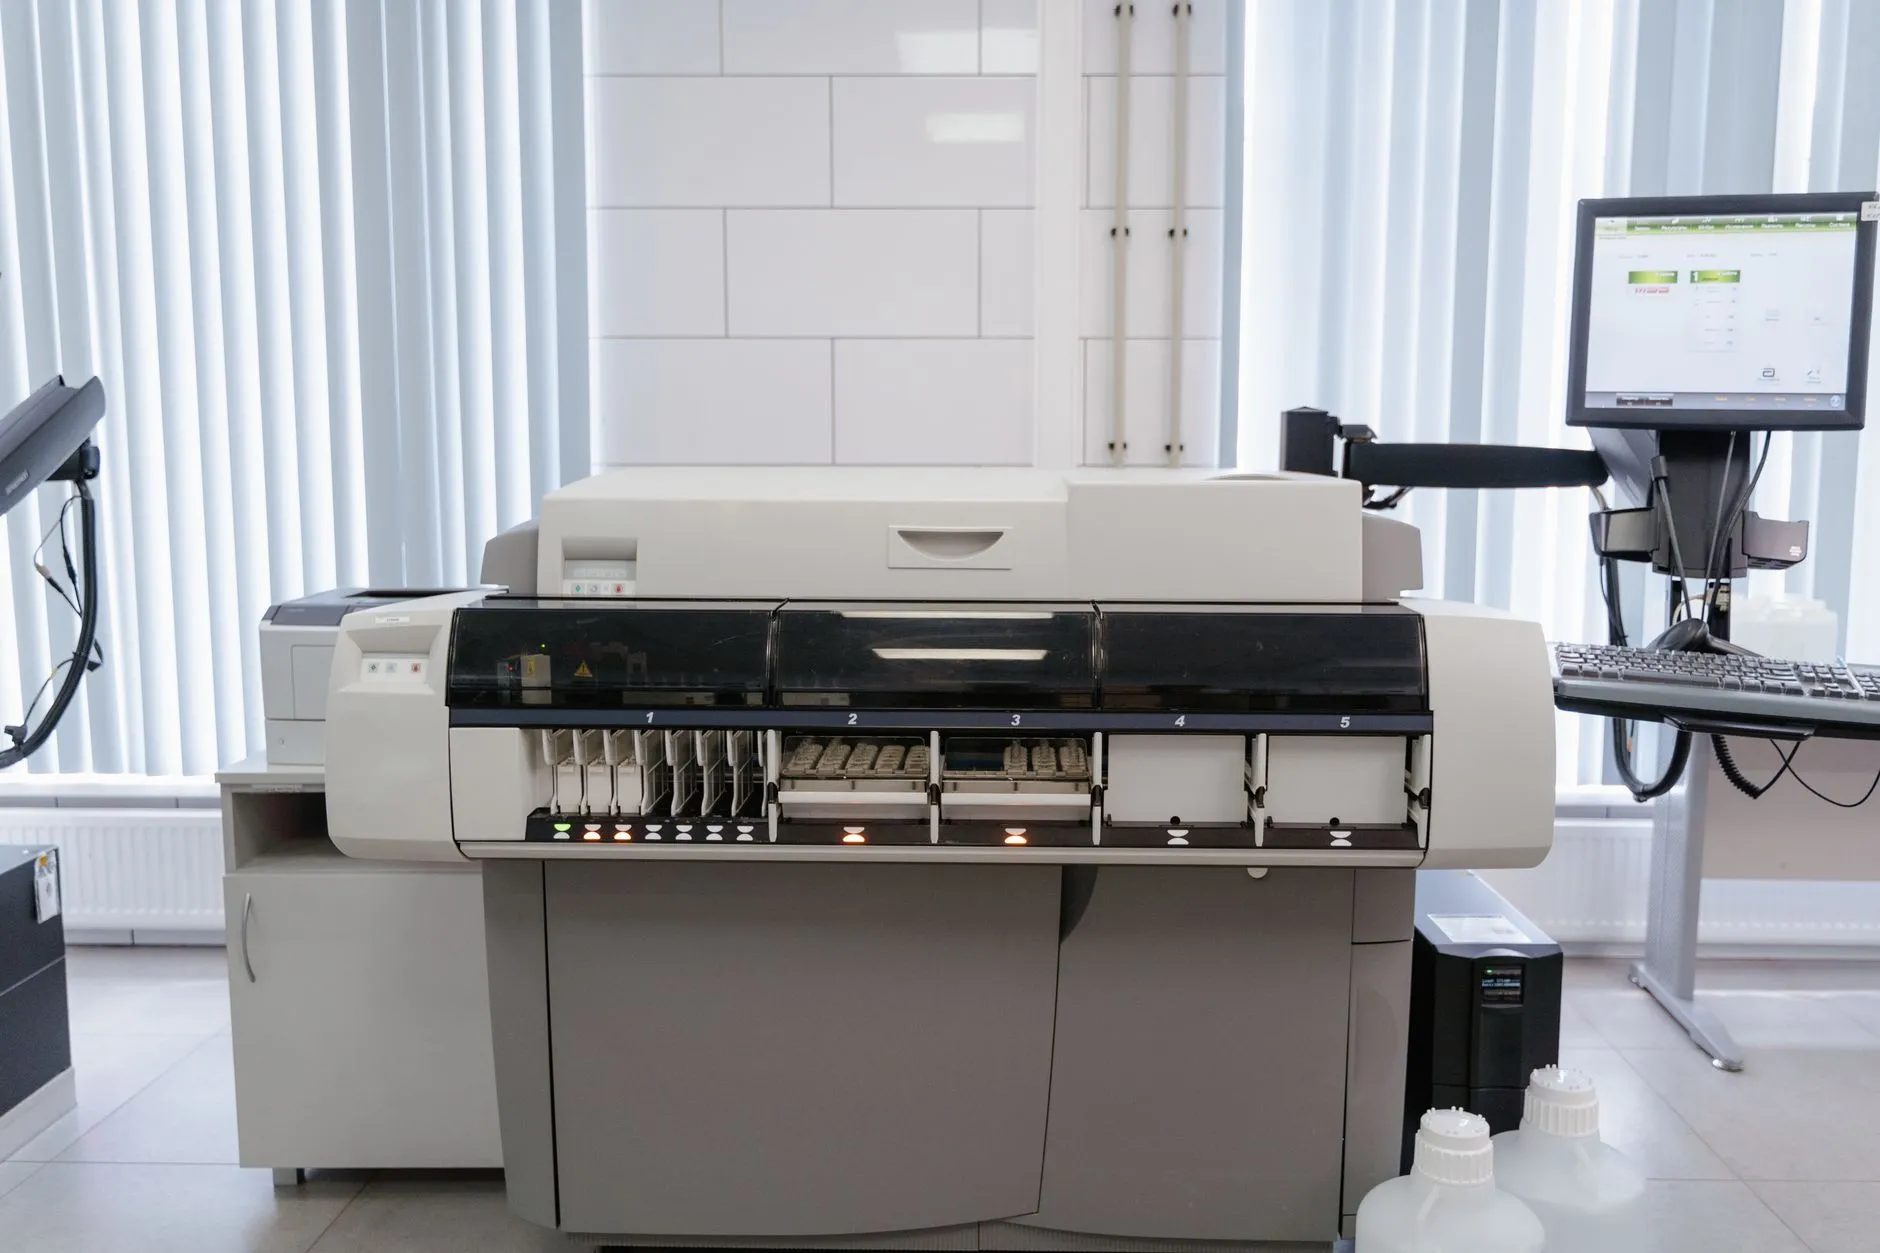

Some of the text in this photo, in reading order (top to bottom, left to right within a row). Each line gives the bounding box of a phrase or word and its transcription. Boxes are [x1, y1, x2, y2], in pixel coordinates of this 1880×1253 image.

[646, 711, 654, 724] 1
[847, 713, 858, 725] 2
[1010, 714, 1021, 726] 3
[1174, 715, 1185, 727] 4
[1340, 716, 1351, 728] 5
